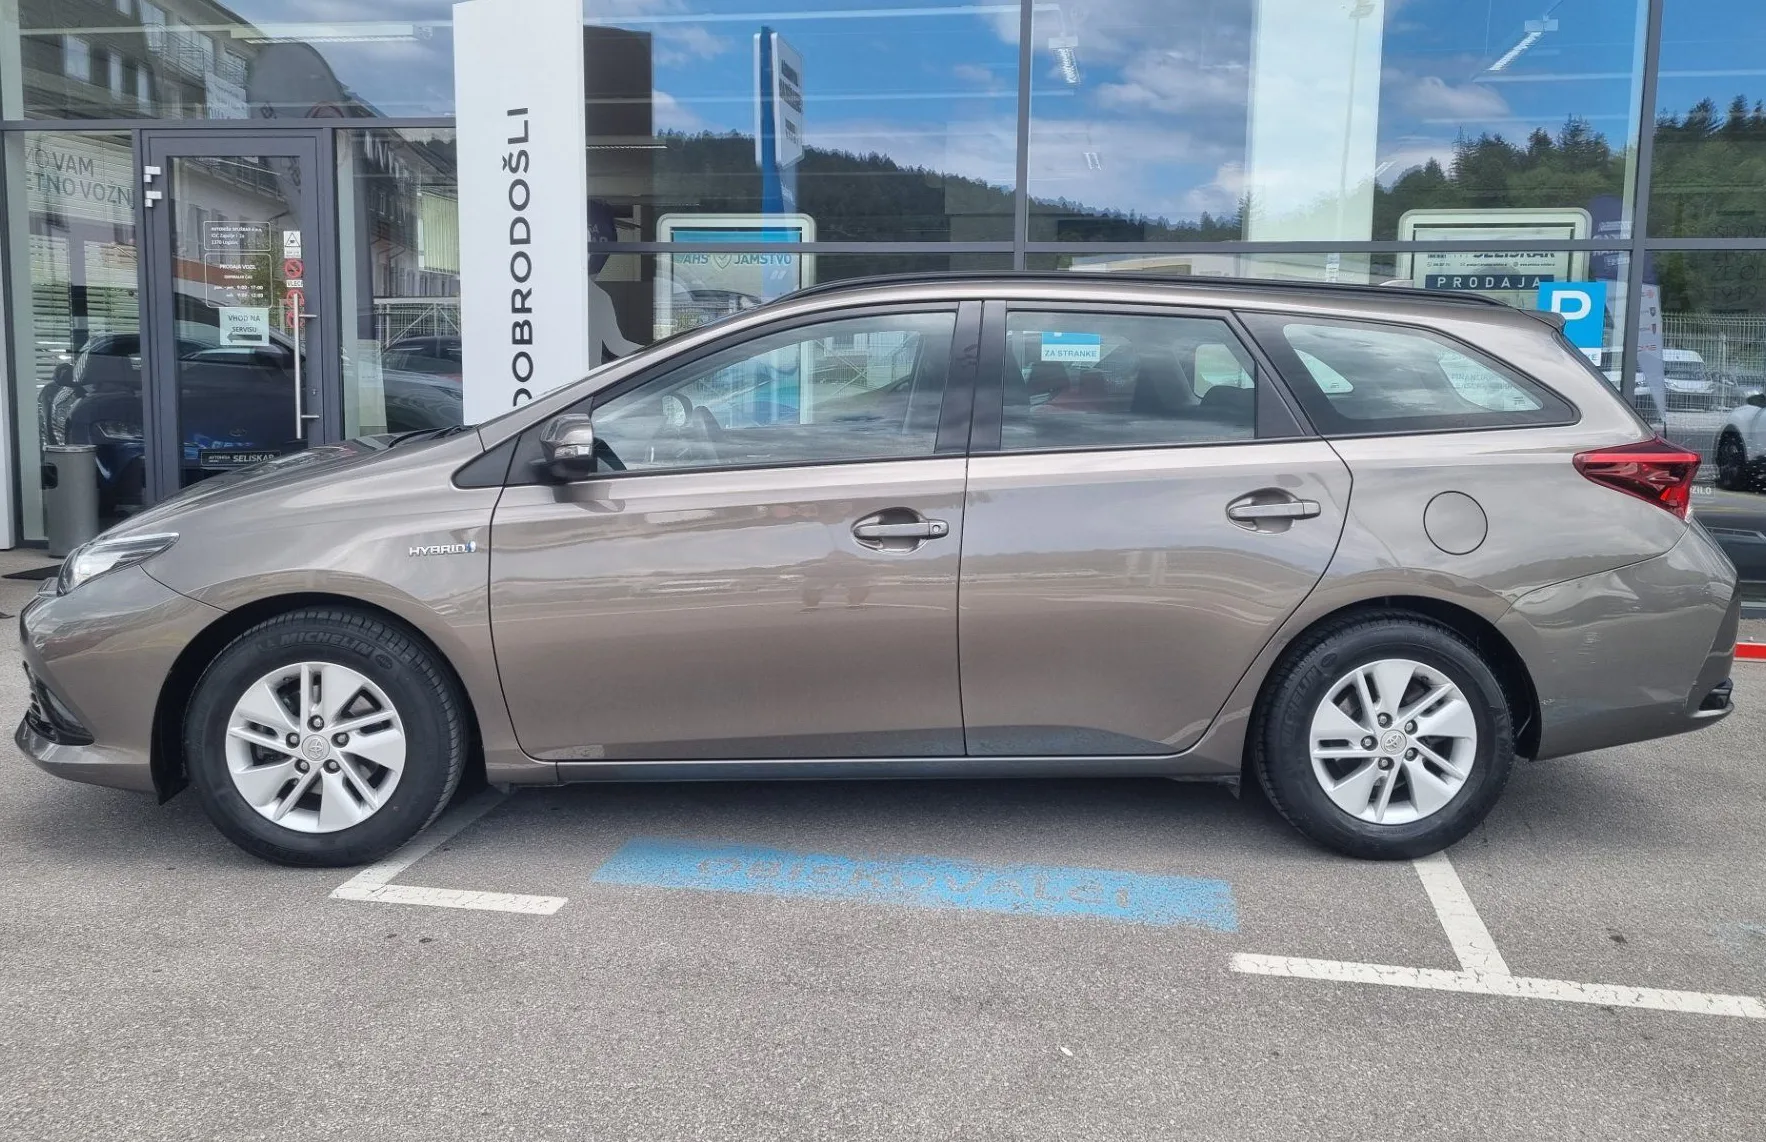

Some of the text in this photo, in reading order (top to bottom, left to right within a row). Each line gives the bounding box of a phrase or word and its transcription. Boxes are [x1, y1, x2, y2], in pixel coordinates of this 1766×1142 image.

[52, 152, 94, 177] VAM
[409, 544, 466, 556] HYBRID
[279, 631, 375, 660] MICHELIN
